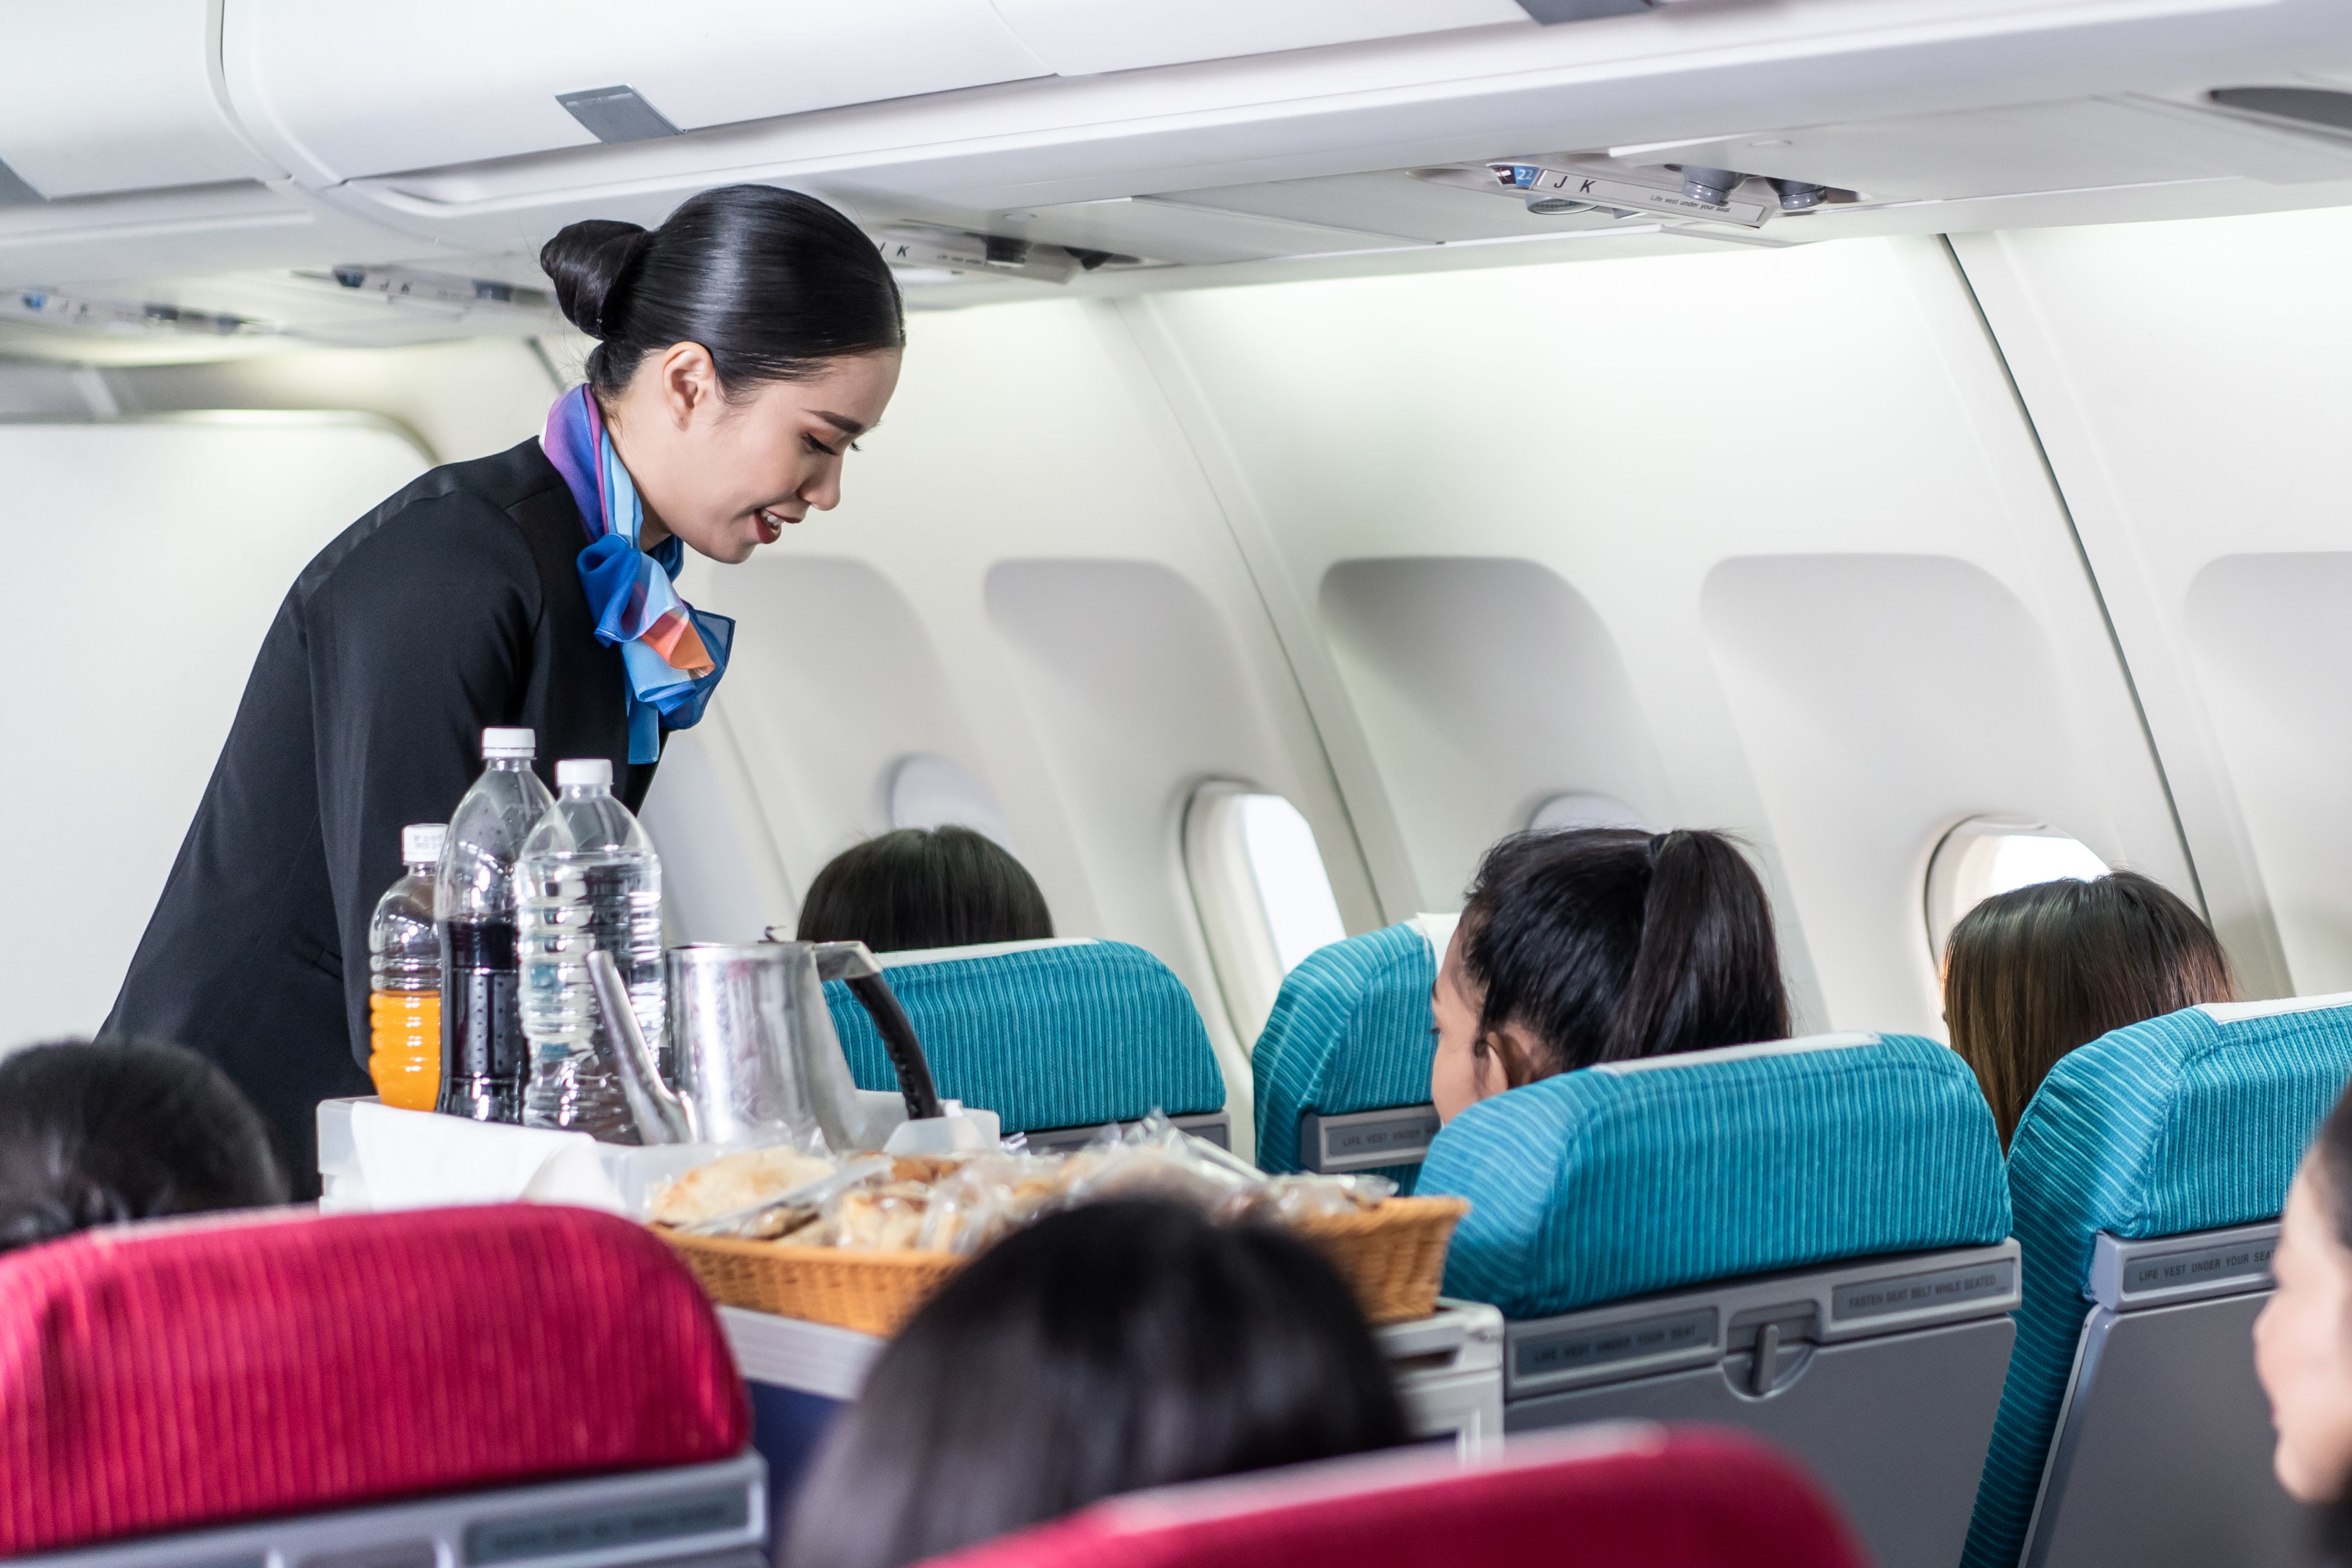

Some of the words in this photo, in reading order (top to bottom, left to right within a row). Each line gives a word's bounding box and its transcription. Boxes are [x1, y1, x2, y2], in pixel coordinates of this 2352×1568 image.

[1517, 169, 1533, 180] 22
[1554, 175, 1568, 188] J
[1580, 179, 1595, 193] K
[2139, 1270, 2158, 1282] LIFE
[2164, 1264, 2186, 1277] VEST
[2191, 1258, 2220, 1273] UNDER
[2226, 1253, 2249, 1267] YOUR
[1911, 1285, 1931, 1299] BELT
[1935, 1280, 1961, 1295] WHILE
[1964, 1274, 1996, 1290] SEATED
